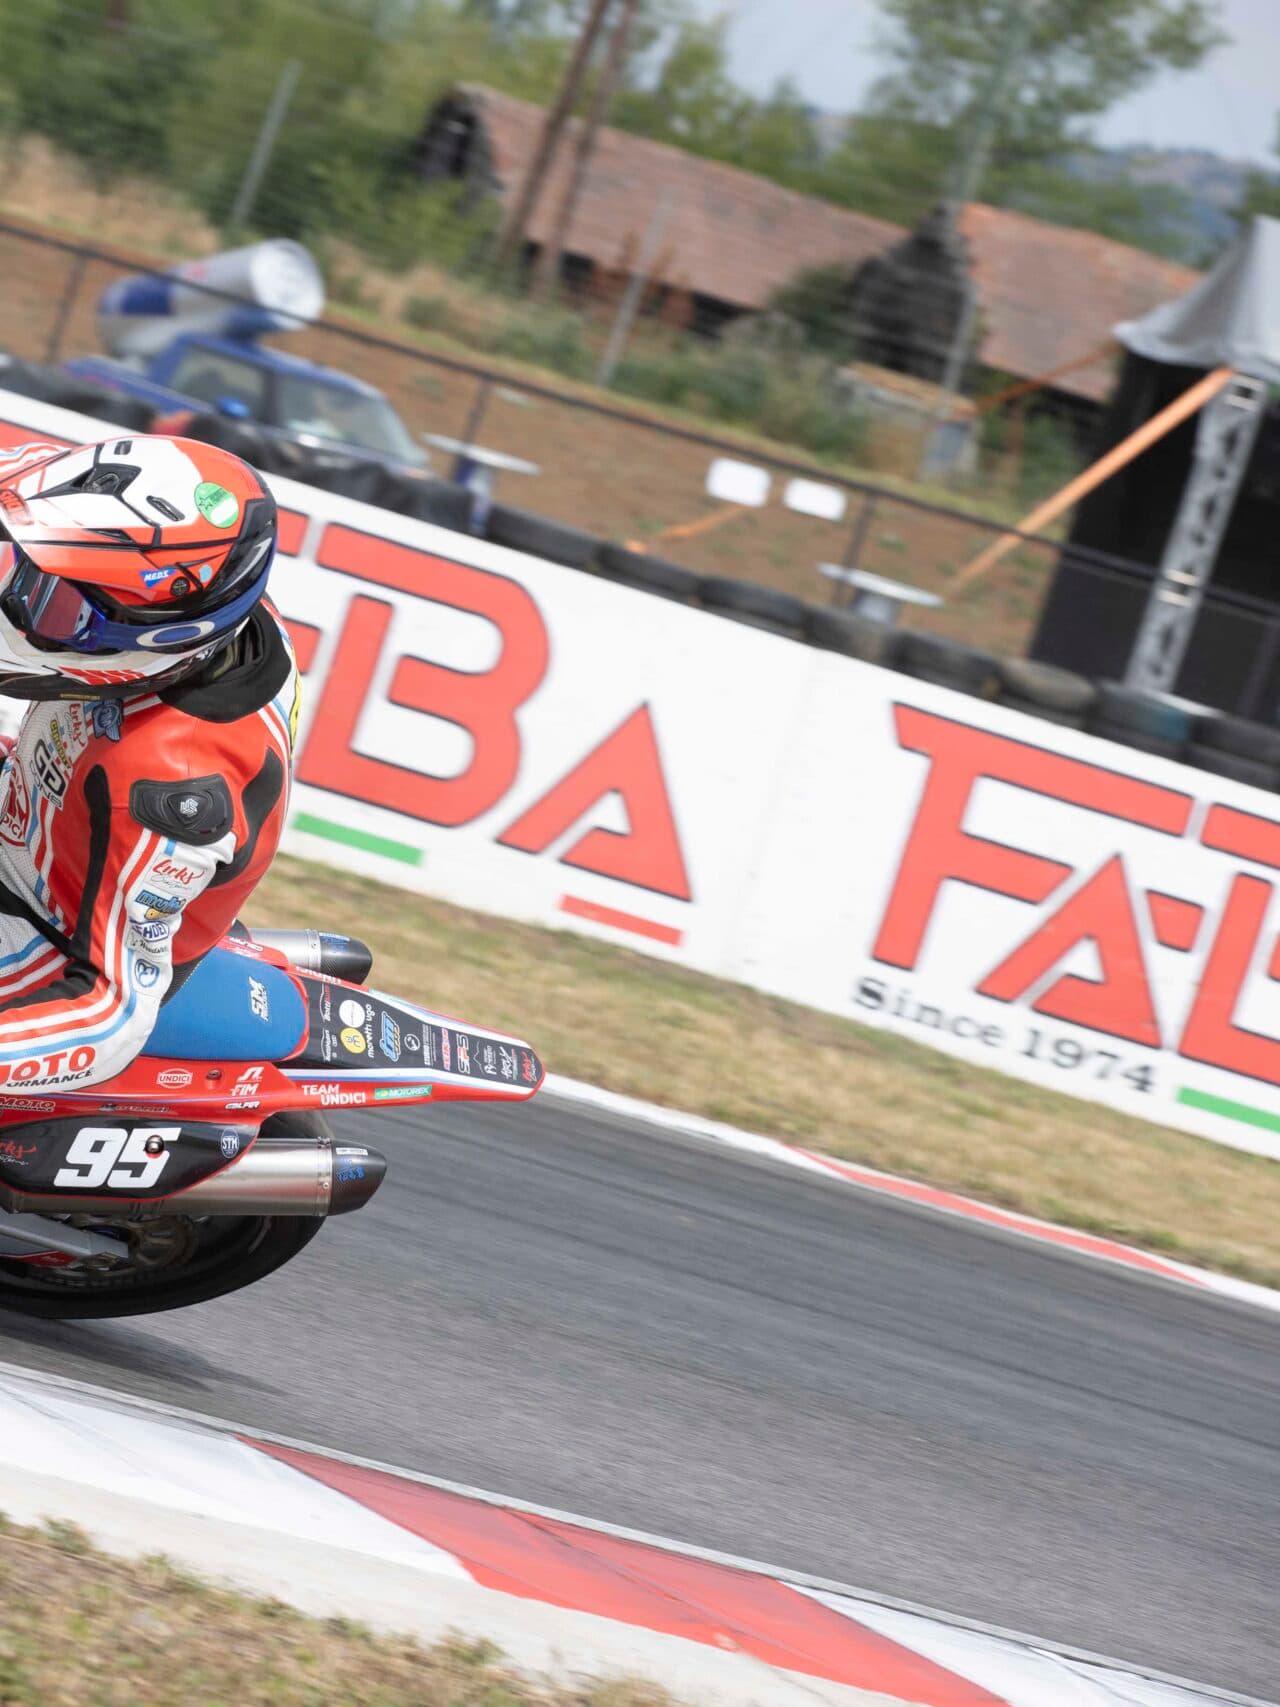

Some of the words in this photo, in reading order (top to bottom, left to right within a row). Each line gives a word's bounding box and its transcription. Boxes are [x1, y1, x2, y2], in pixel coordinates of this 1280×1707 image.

[853, 977, 1003, 1049] Since
[1023, 1027, 1158, 1094] 1974
[159, 1075, 191, 1083] UNDICI
[230, 1083, 259, 1096] FIM
[301, 1083, 341, 1096] TEAM
[321, 1092, 367, 1105] UNDICI
[222, 1137, 238, 1150] STM
[53, 1127, 182, 1189] 95
